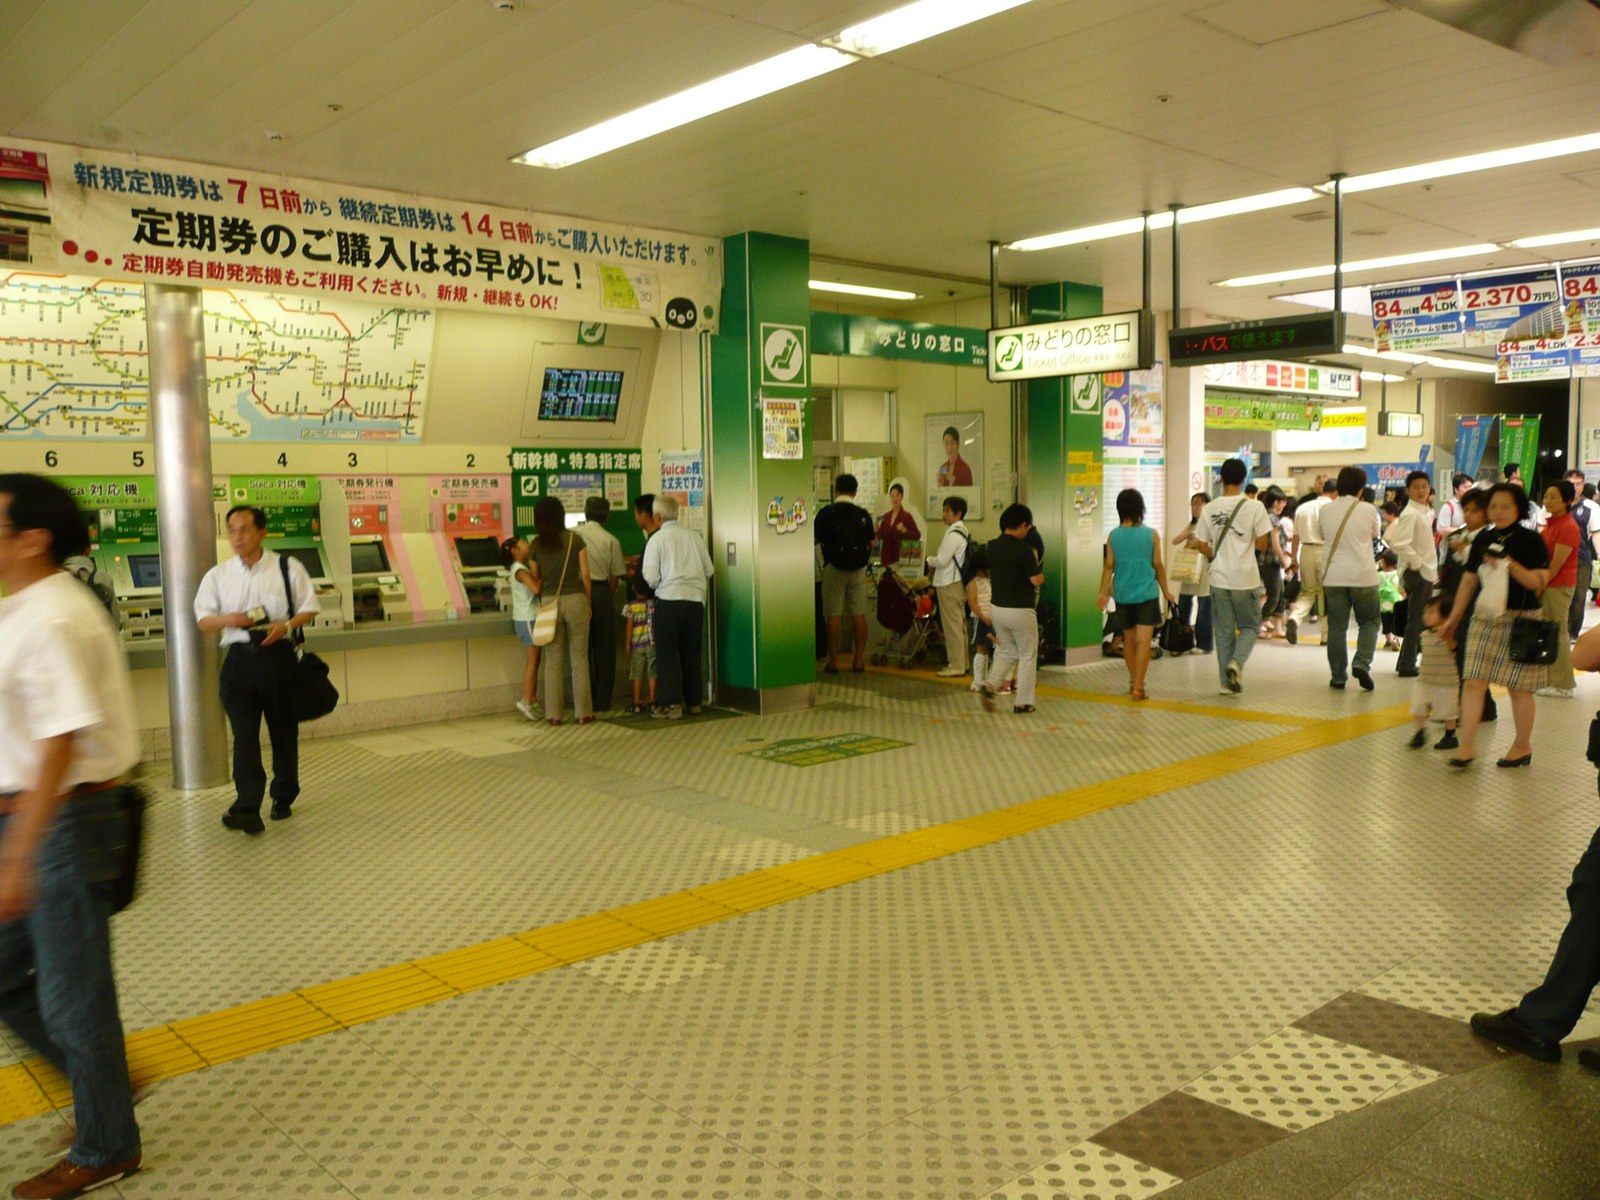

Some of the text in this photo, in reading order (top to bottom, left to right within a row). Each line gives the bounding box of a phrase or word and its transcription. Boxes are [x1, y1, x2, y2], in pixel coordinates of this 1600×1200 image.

[878, 329, 965, 353] みどりの窓口
[1026, 322, 1131, 351] みどりの窓口
[45, 451, 58, 467] 6
[132, 451, 145, 467] 5
[277, 453, 288, 467] 4
[347, 453, 358, 467] 3
[466, 454, 475, 467] 2
[512, 451, 641, 470] 新幹線・特急指定席
